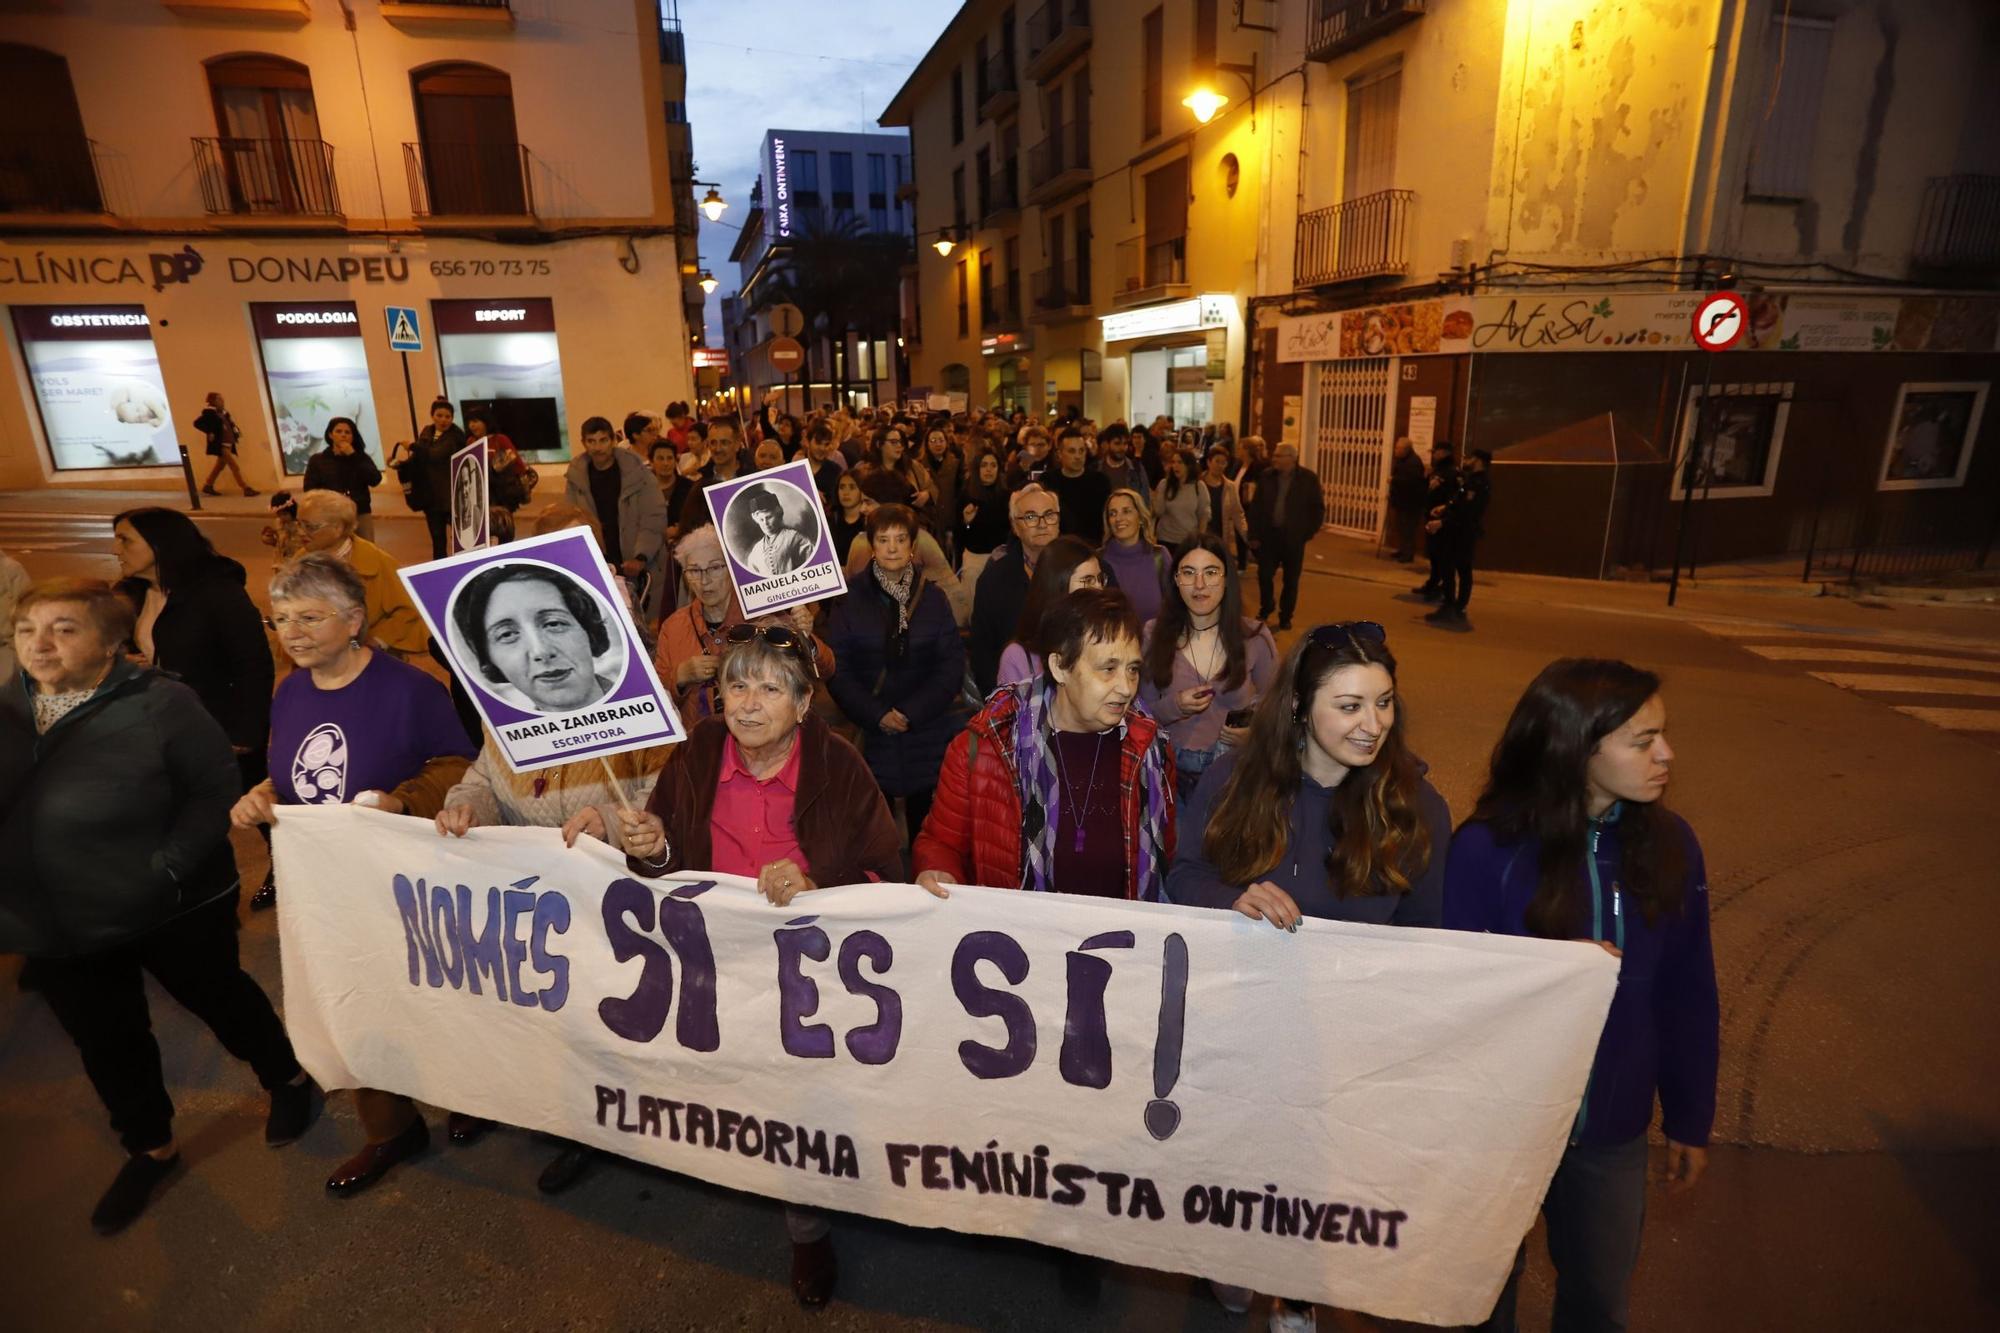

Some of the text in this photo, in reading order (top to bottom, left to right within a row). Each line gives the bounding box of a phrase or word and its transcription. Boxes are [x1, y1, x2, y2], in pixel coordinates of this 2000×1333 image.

[774, 138, 790, 237] CAIXA ONTINYENT
[0, 252, 145, 284] CLÍNICA
[430, 260, 466, 276] 656
[469, 260, 495, 276] 70
[499, 260, 523, 276] 73
[526, 260, 551, 276] 75
[51, 313, 150, 327] OBSTETRICIA
[276, 311, 357, 324] PODOLOGIA
[475, 309, 526, 322] ESPORT
[38, 377, 69, 386] VOLS
[40, 388, 63, 397] SER
[744, 564, 832, 596] MANUELA SOLÍS
[505, 702, 655, 742] MARIA ZAMBRANO
[552, 726, 626, 749] ESCRIPTORA
[392, 873, 571, 1012] NOMÉS
[597, 877, 720, 1052] SÍ
[774, 914, 904, 1065] ÉS
[595, 1085, 860, 1179] PLATAFORMA
